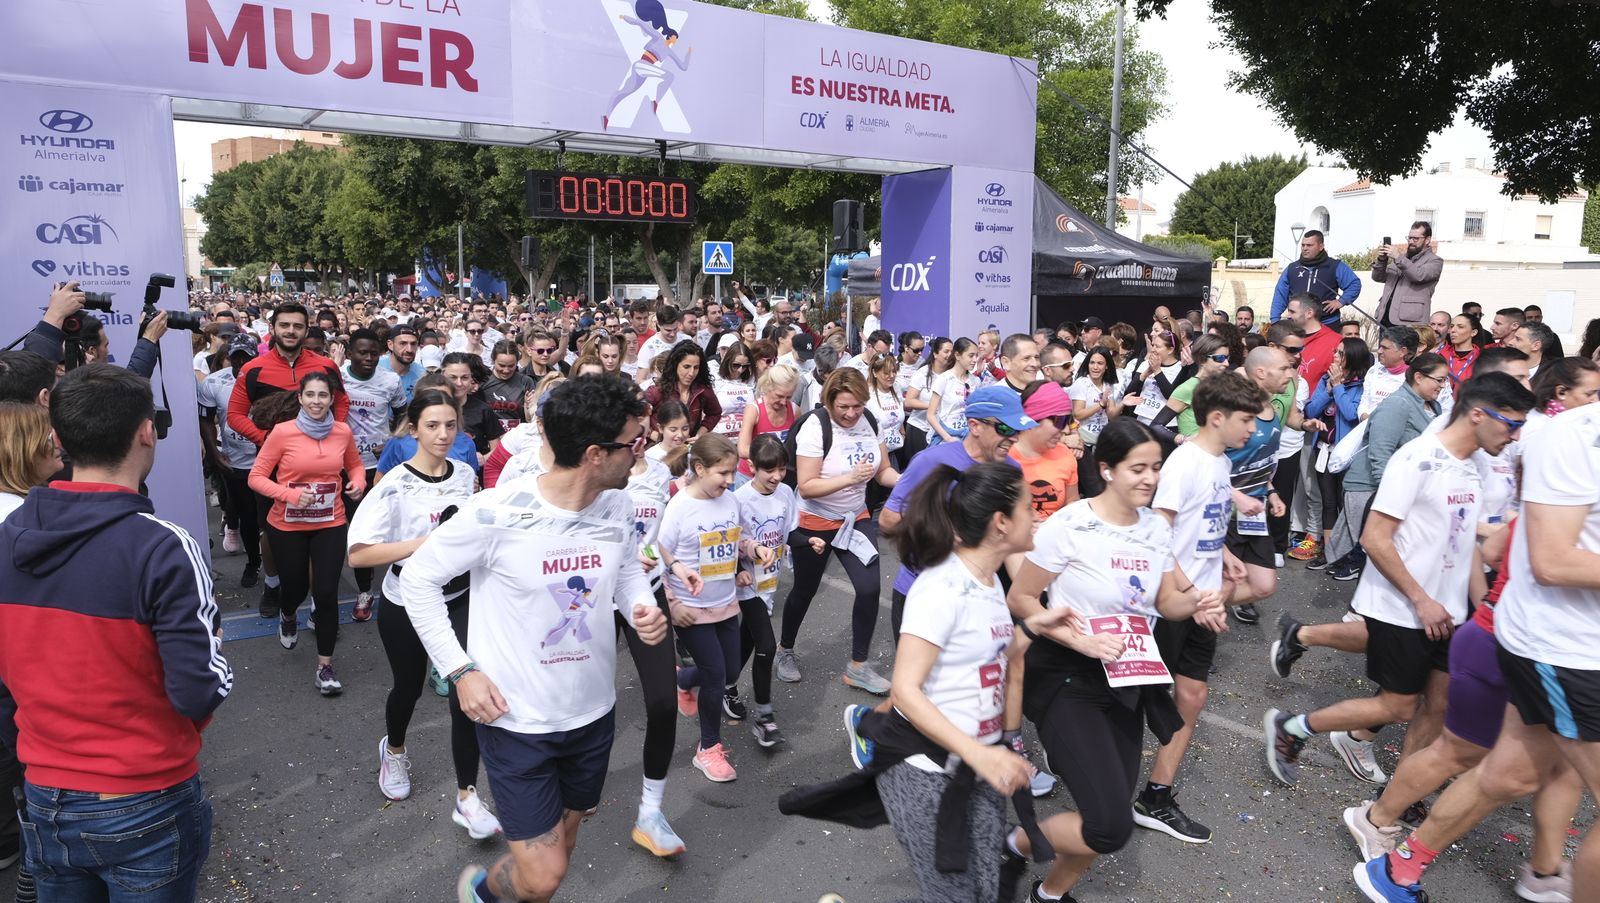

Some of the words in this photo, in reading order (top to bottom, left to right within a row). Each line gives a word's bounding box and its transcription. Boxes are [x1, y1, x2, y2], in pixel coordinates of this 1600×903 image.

[185, 0, 479, 93] MUJER
[820, 47, 842, 68] LA
[847, 51, 931, 81] IGUALDAD
[791, 75, 815, 96] ES
[819, 79, 902, 107] NUESTRA
[905, 91, 955, 114] META.
[800, 111, 829, 130] CDX
[859, 116, 890, 128] ALMERÍA
[20, 134, 115, 150] HYUNDAI
[34, 149, 106, 162] Almerialva
[50, 178, 124, 195] cajamar
[559, 176, 687, 217] 00:00:00
[977, 197, 1012, 207] HYUNDAI
[36, 222, 102, 245] CASI
[985, 223, 1014, 233] cajamar
[63, 261, 130, 277] vithas
[890, 255, 936, 291] CDX
[985, 272, 1011, 283] vithas
[979, 302, 1010, 315] aqualia
[94, 309, 134, 326] alia
[847, 452, 875, 466] 139
[543, 554, 602, 575] MUJER
[1111, 557, 1150, 571] MUJER
[1122, 634, 1147, 653] 42
